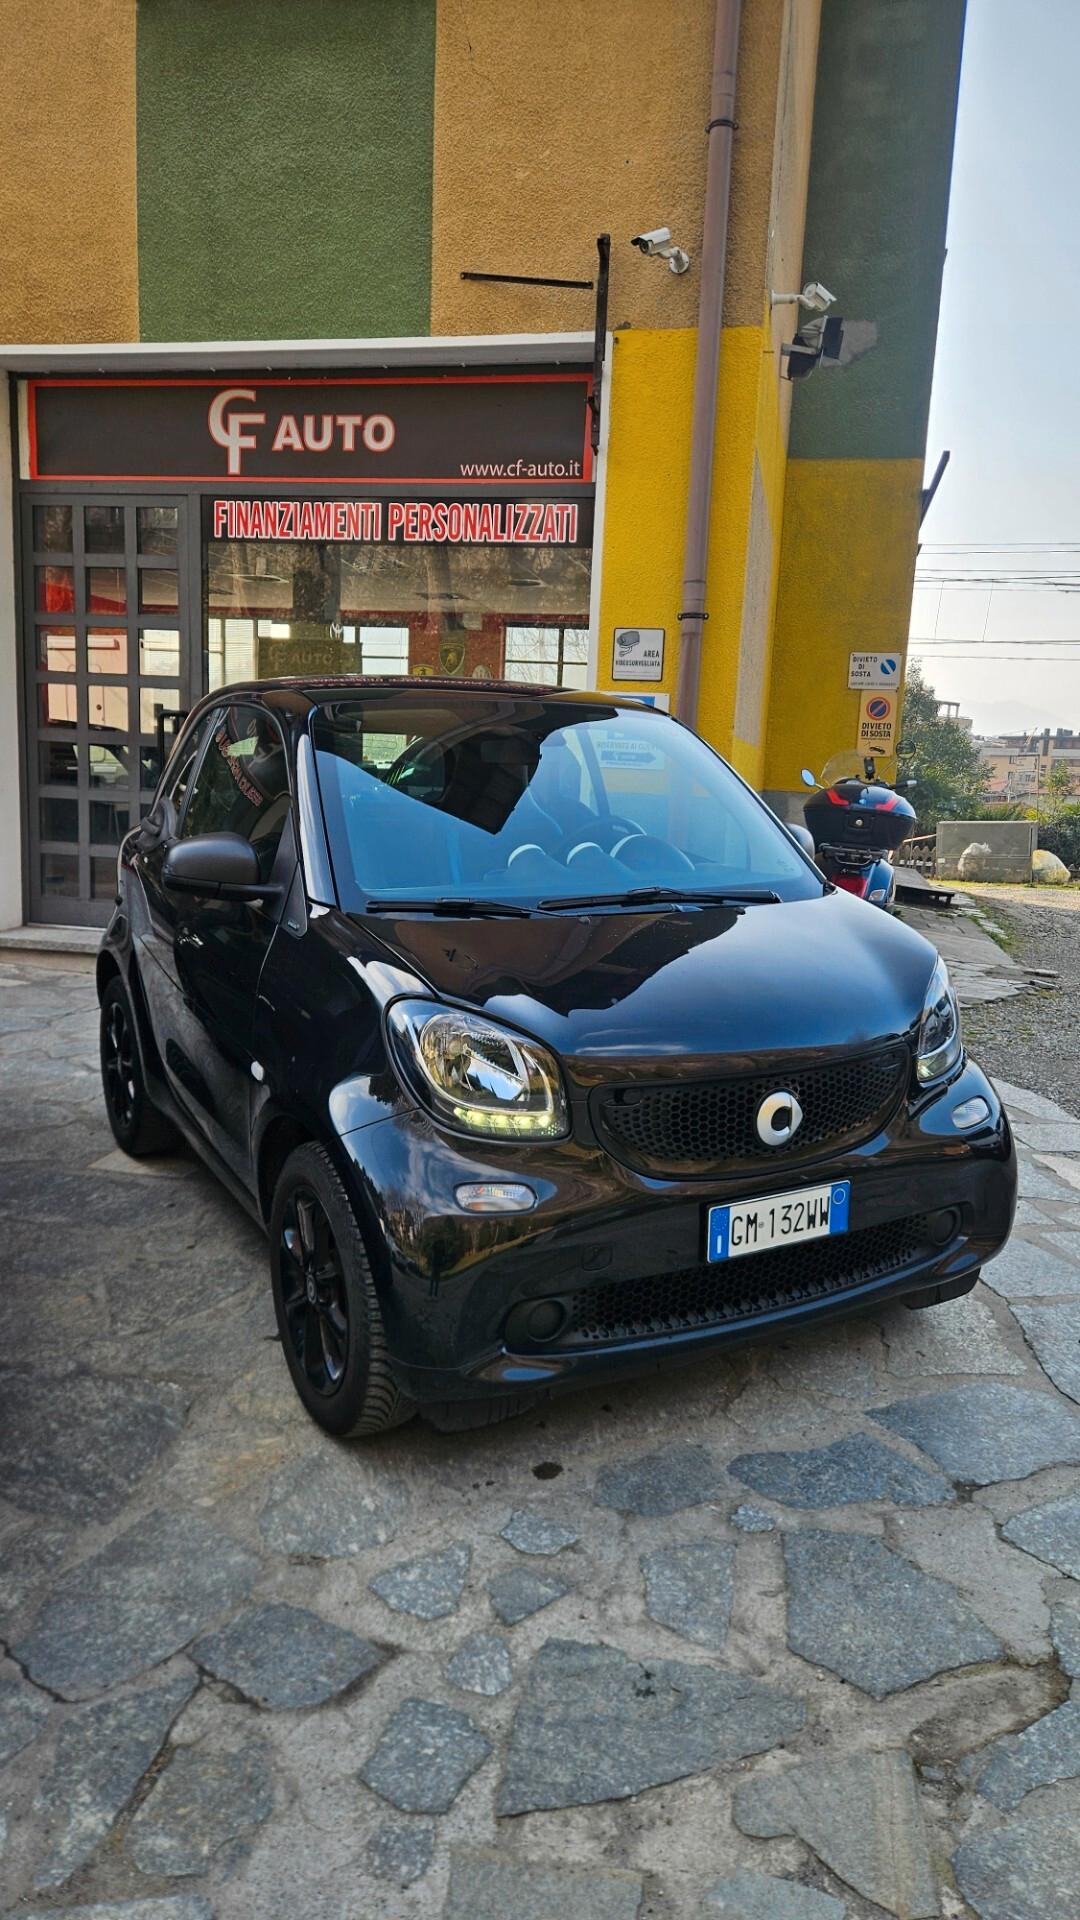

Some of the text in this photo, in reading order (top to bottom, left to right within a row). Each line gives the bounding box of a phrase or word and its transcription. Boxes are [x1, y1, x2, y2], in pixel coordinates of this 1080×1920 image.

[208, 389, 396, 476] CF AUTO
[460, 459, 581, 477] www.cf-auto.it
[213, 500, 579, 543] FINANZIAMENTI PERSONALIZZATI
[643, 649, 660, 658] AREA
[861, 722, 892, 730] DIVIETO
[861, 730, 891, 738] DI SOSTA
